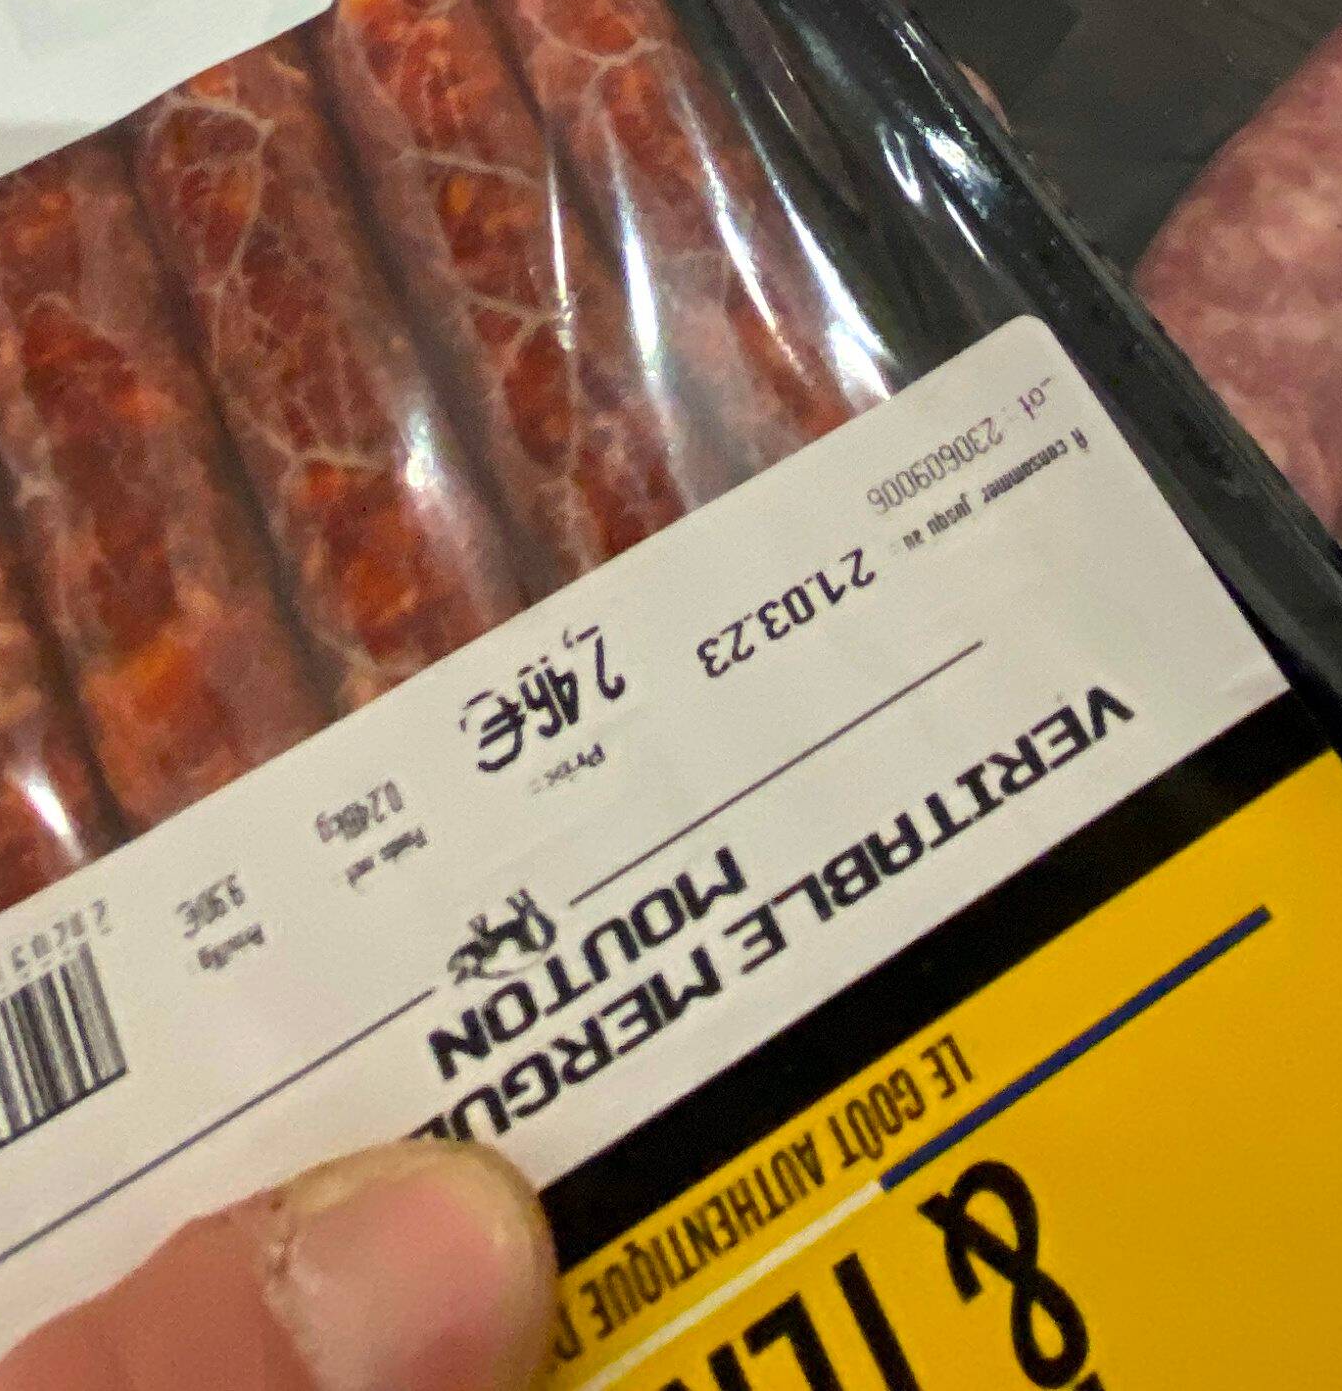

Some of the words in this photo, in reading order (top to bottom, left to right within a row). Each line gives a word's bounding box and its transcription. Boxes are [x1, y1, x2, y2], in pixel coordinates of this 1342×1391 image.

[866, 416, 1004, 514] 230609006
[981, 438, 1069, 504] consommer
[696, 547, 876, 679] 21.03.23
[459, 625, 626, 773] 2,46€
[722, 686, 1135, 975] VERITABLE
[428, 846, 748, 1081] MOUTON
[827, 1067, 927, 1170] GOÛT
[920, 1033, 974, 1100] LE
[576, 1132, 826, 1340] AUTHENTIQUE
